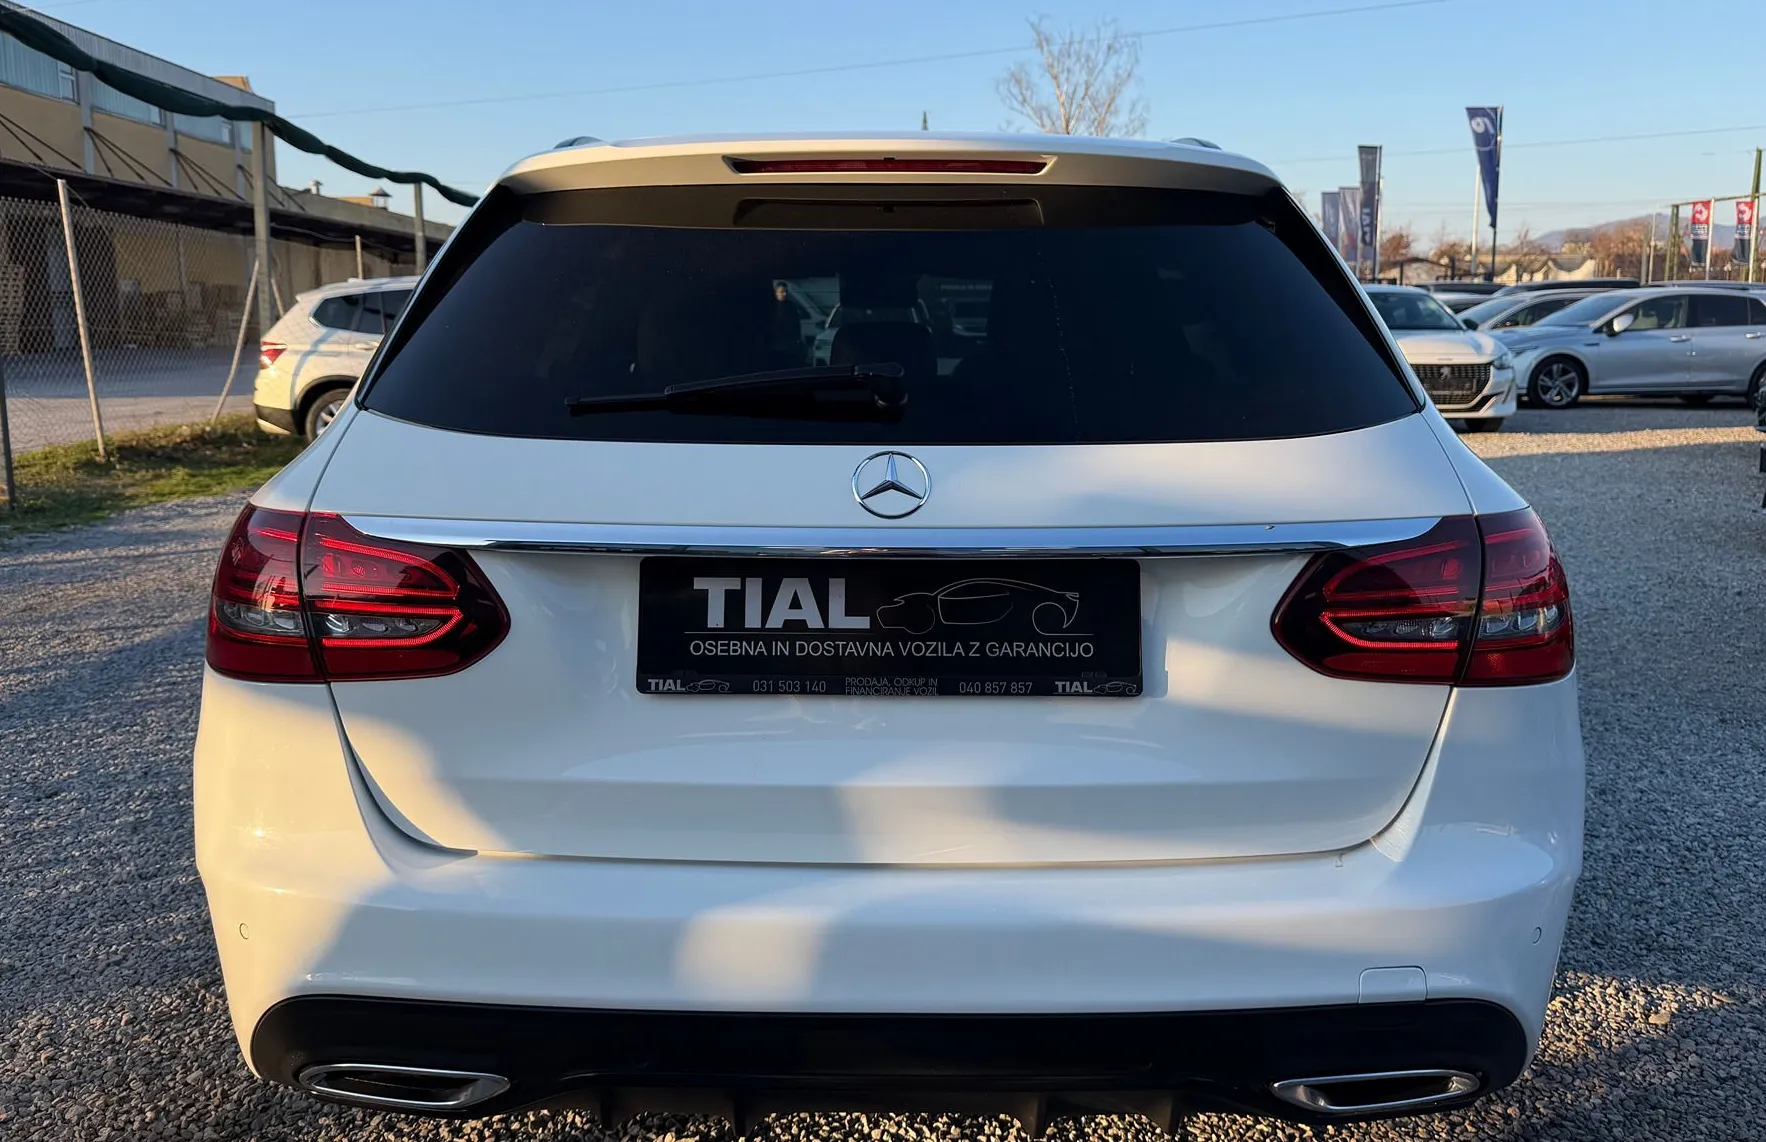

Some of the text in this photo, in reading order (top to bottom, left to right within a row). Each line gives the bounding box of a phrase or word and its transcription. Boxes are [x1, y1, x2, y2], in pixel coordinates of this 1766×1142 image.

[694, 577, 870, 628] TIAL
[690, 640, 1094, 658] OSEBNA IN DOSTAVNA VOZILA Z GARANCIJO
[648, 679, 685, 691] TIAL
[752, 680, 827, 692] 031 503 140
[845, 677, 938, 687] PRODAJA, ODKUP IN
[959, 681, 1033, 694] 040 857 857
[1055, 681, 1093, 693] TIAL
[845, 686, 939, 696] FINANCIRANJE VOZIL
